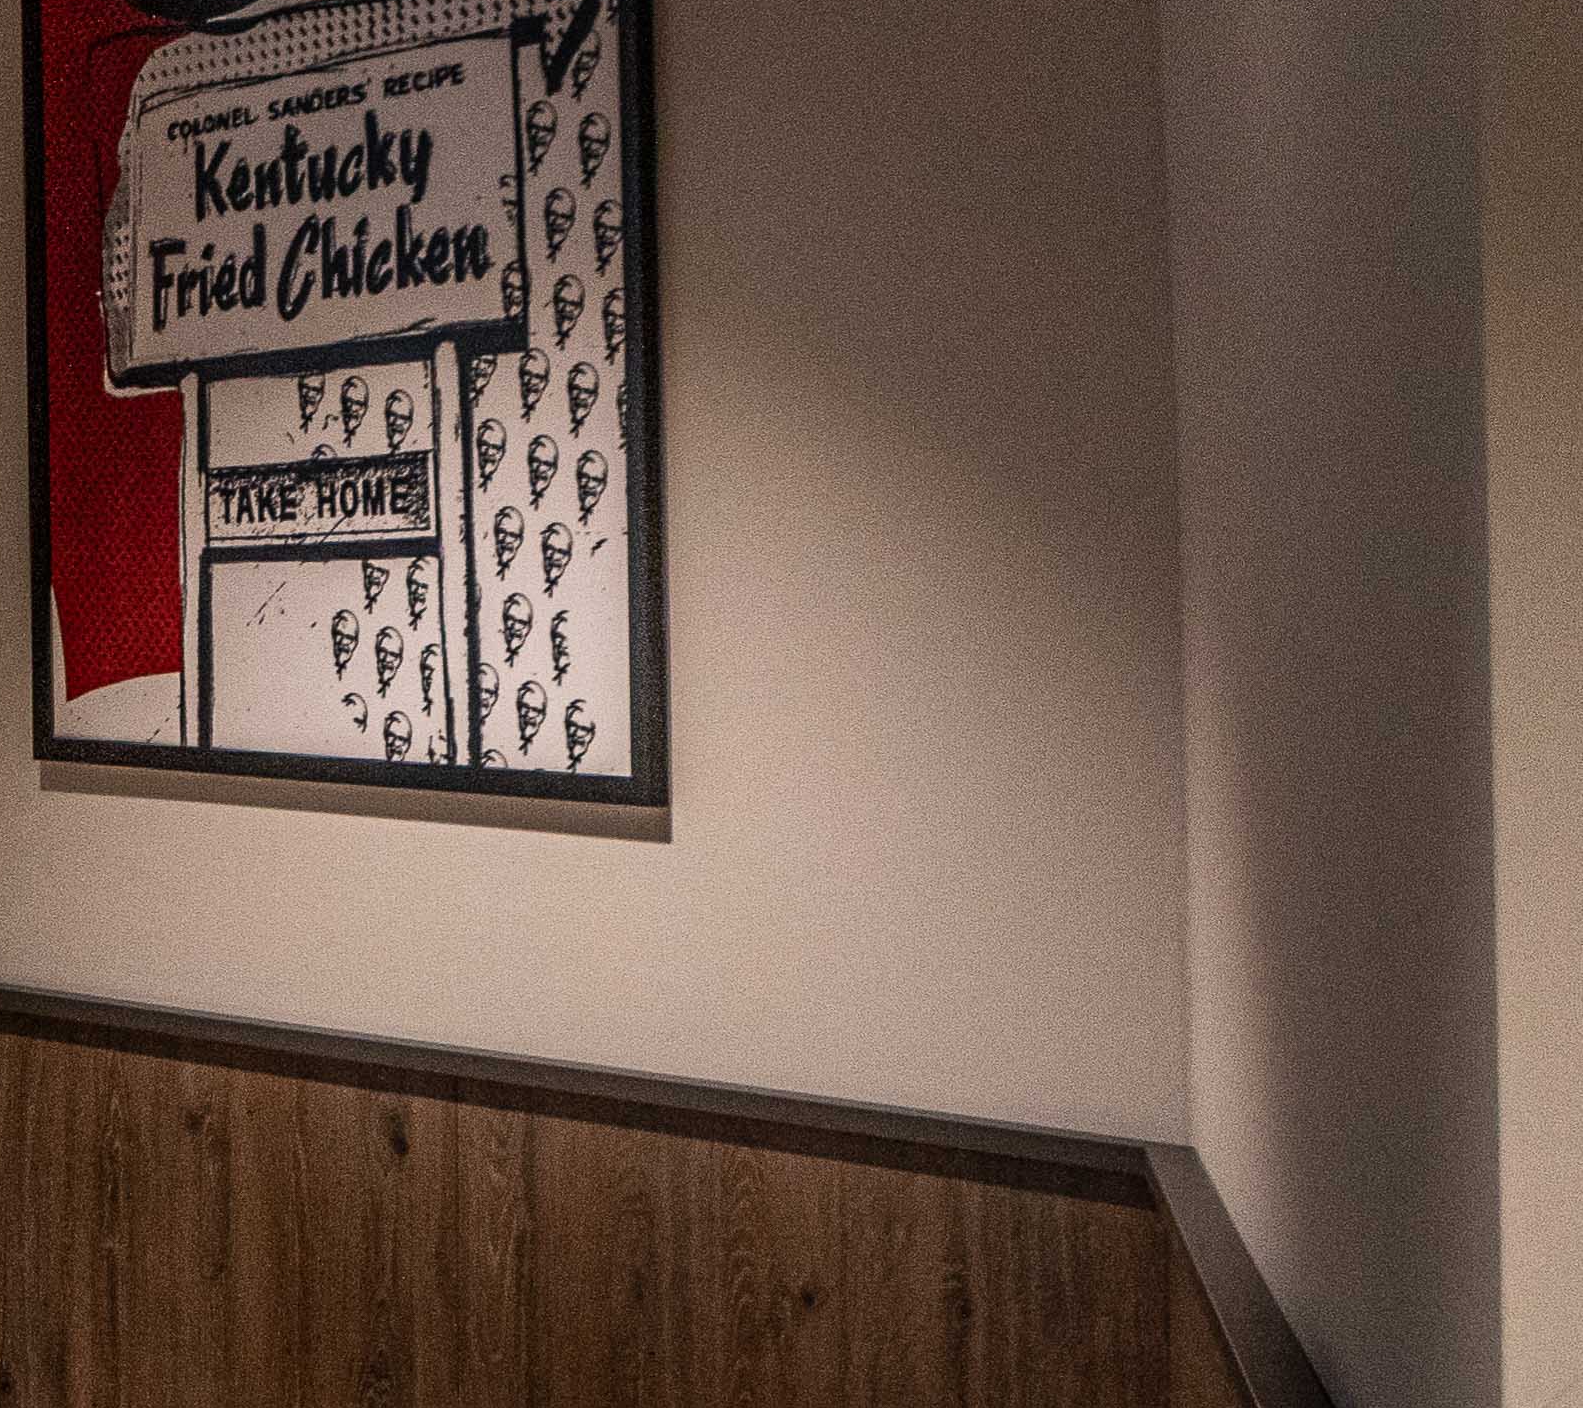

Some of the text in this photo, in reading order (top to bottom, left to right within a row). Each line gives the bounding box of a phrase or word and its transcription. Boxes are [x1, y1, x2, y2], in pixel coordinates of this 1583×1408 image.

[166, 61, 466, 140] COLONEL SANDERS' RECIPE
[194, 109, 434, 221] Kentucky
[150, 204, 490, 332] Fried Chicken
[218, 478, 412, 526] TAKE HOME
